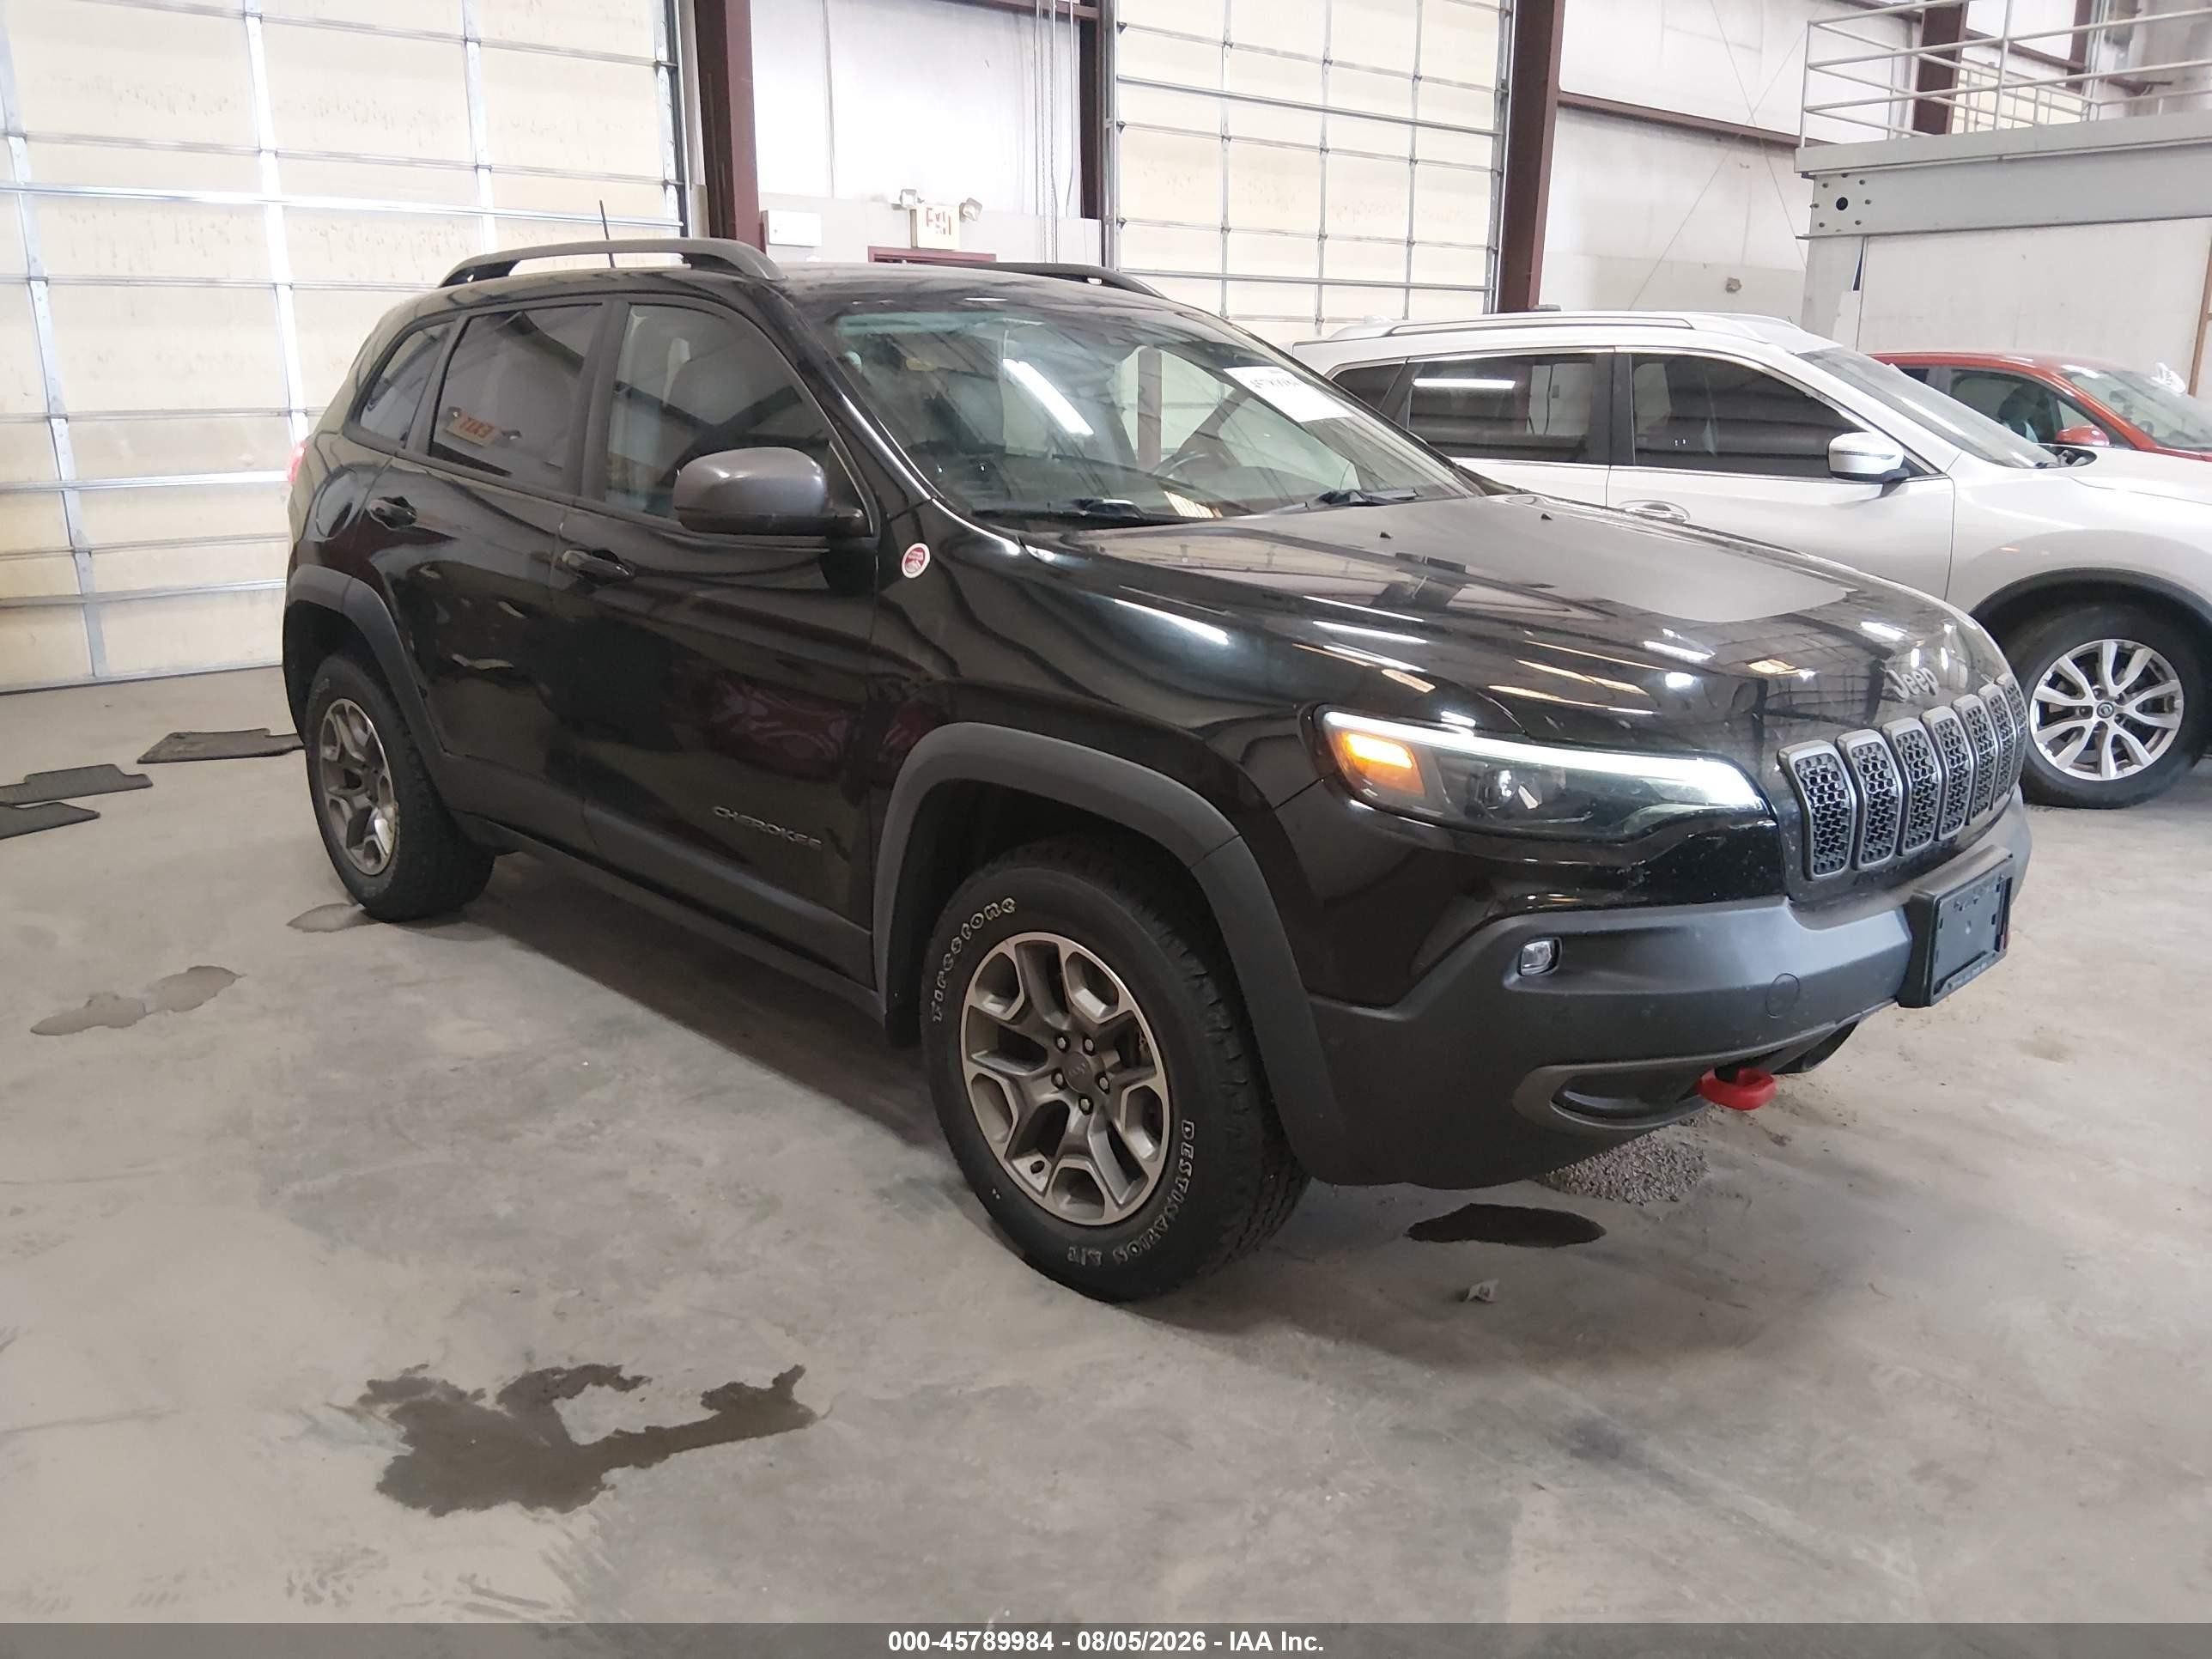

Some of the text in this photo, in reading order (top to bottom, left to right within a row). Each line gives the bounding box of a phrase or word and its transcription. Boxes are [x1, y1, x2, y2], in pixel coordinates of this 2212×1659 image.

[1887, 667, 1940, 700] Jeep
[714, 806, 823, 848] CHEROKEE
[1113, 1119, 1195, 1264] DESTINATION
